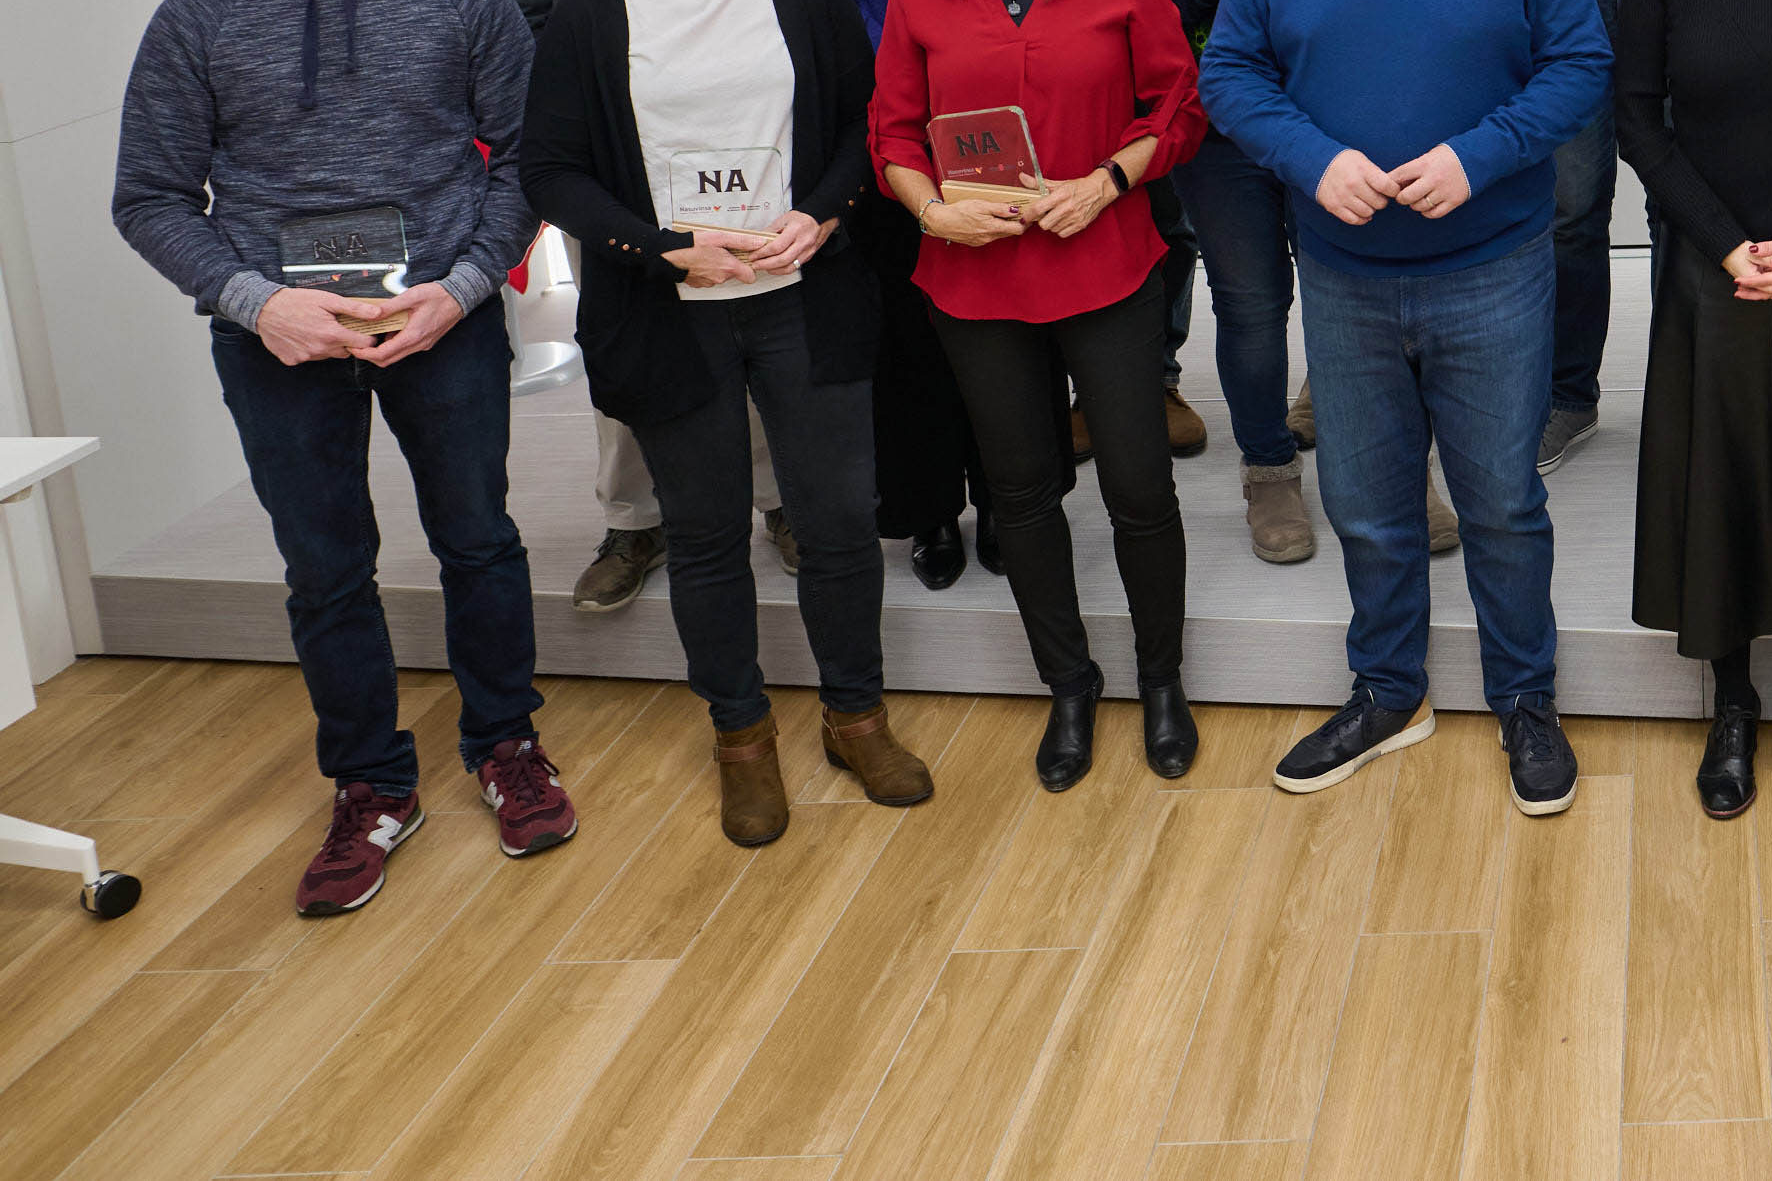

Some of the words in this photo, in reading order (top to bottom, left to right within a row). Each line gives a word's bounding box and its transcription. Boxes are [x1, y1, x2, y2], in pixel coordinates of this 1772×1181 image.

[955, 131, 1001, 156] NA
[697, 169, 750, 194] NA
[312, 232, 369, 260] NA
